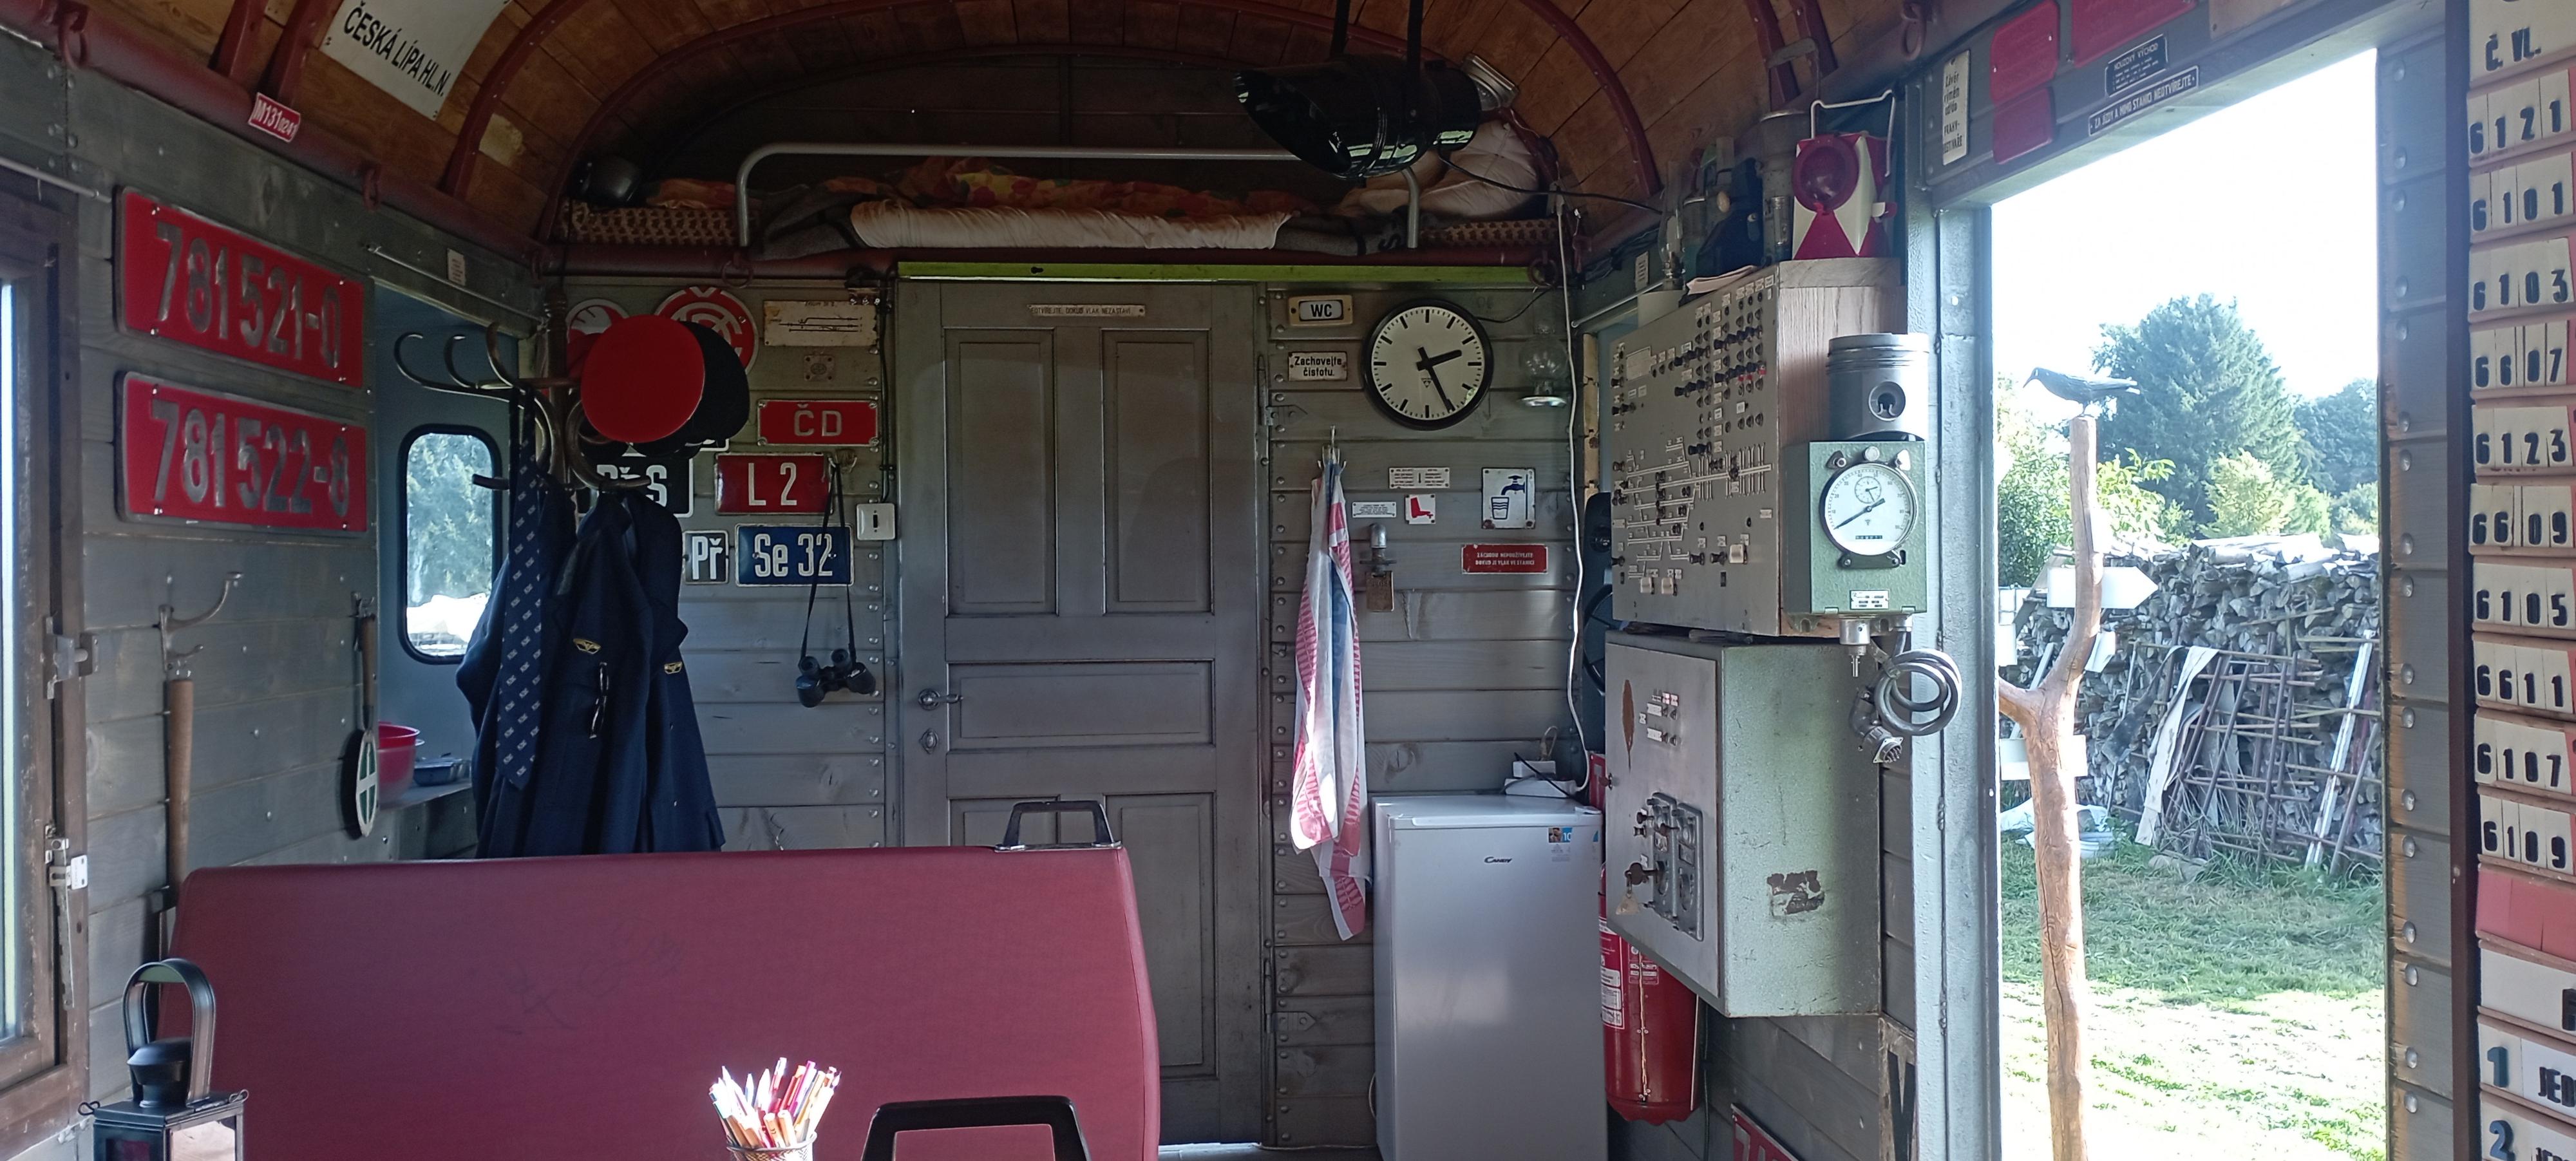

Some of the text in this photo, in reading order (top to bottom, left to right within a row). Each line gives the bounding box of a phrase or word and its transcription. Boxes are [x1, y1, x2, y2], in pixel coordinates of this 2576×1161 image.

[343, 1, 402, 61] ČESKÁ
[390, 39, 426, 79] LÍPA
[2485, 26, 2542, 71] Č. VL.
[2469, 100, 2562, 155] 6121
[2472, 180, 2564, 231] 6101
[156, 220, 341, 369] 781 521-0
[1310, 303, 1332, 317] WC
[2473, 269, 2568, 311] 6103
[1294, 355, 1342, 367] Zachovejte
[2475, 347, 2562, 388] 6607
[793, 403, 842, 437] ČD
[150, 398, 350, 518] 781 522-8
[2475, 428, 2566, 465] 6123
[748, 462, 797, 505] L 2
[2472, 511, 2567, 545] 6609
[692, 536, 723, 580] Př
[754, 533, 833, 577] Se 32
[2476, 589, 2568, 627] 6105
[2476, 664, 2564, 708] 6611
[2477, 742, 2561, 788] 6107
[2483, 820, 2566, 869] 6109
[2486, 1046, 2576, 1108] 1 JED
[2489, 1120, 2515, 1161] 2
